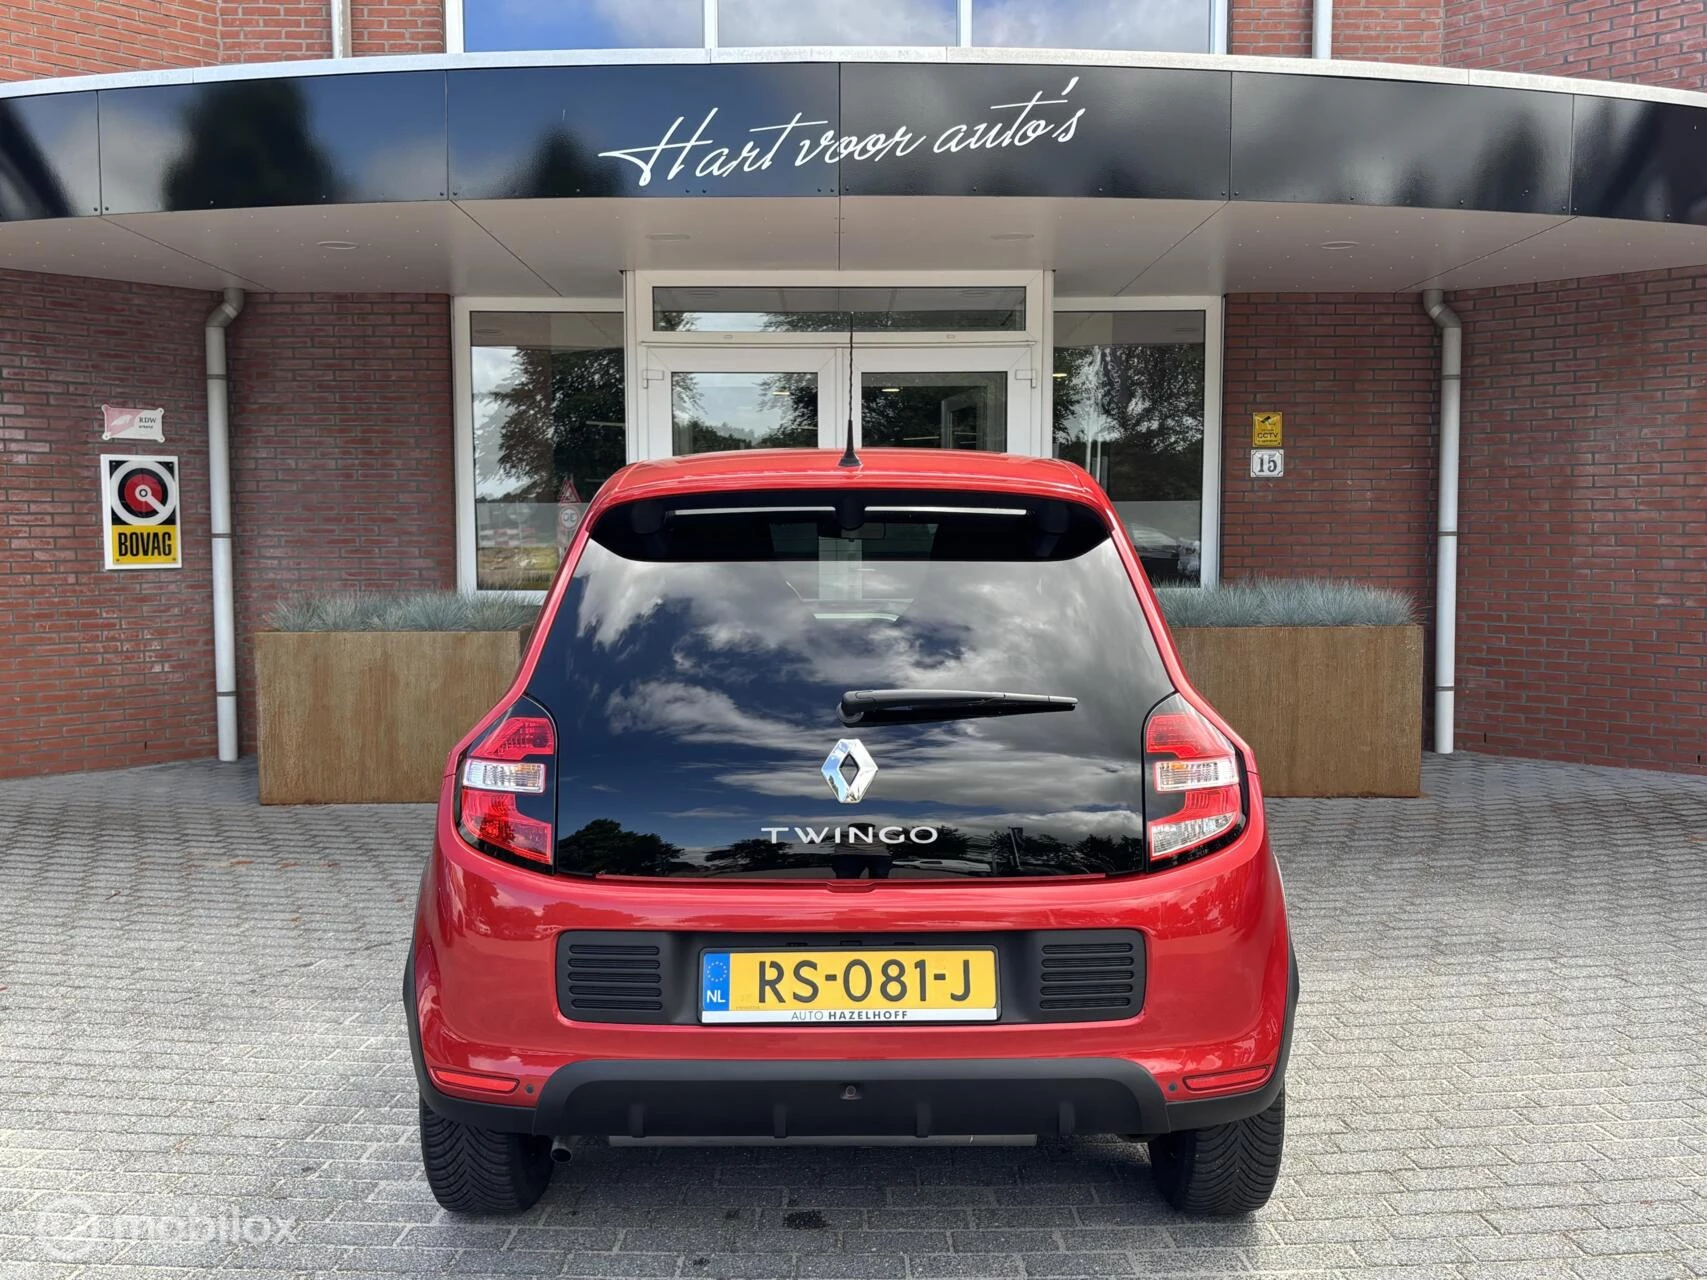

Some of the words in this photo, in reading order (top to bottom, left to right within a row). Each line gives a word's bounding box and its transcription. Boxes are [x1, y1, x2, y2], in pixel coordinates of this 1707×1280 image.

[598, 107, 828, 187] Hart
[794, 128, 927, 167] voor
[933, 76, 1086, 154] auto's
[138, 416, 157, 424] RDW
[1258, 453, 1278, 473] 15
[118, 531, 172, 557] BOVAG
[760, 826, 938, 845] TWINGO
[758, 958, 970, 1003] RS-081-J
[706, 990, 726, 1003] NL
[791, 1010, 824, 1021] AUTO
[828, 1010, 909, 1020] HAZELHOFF
